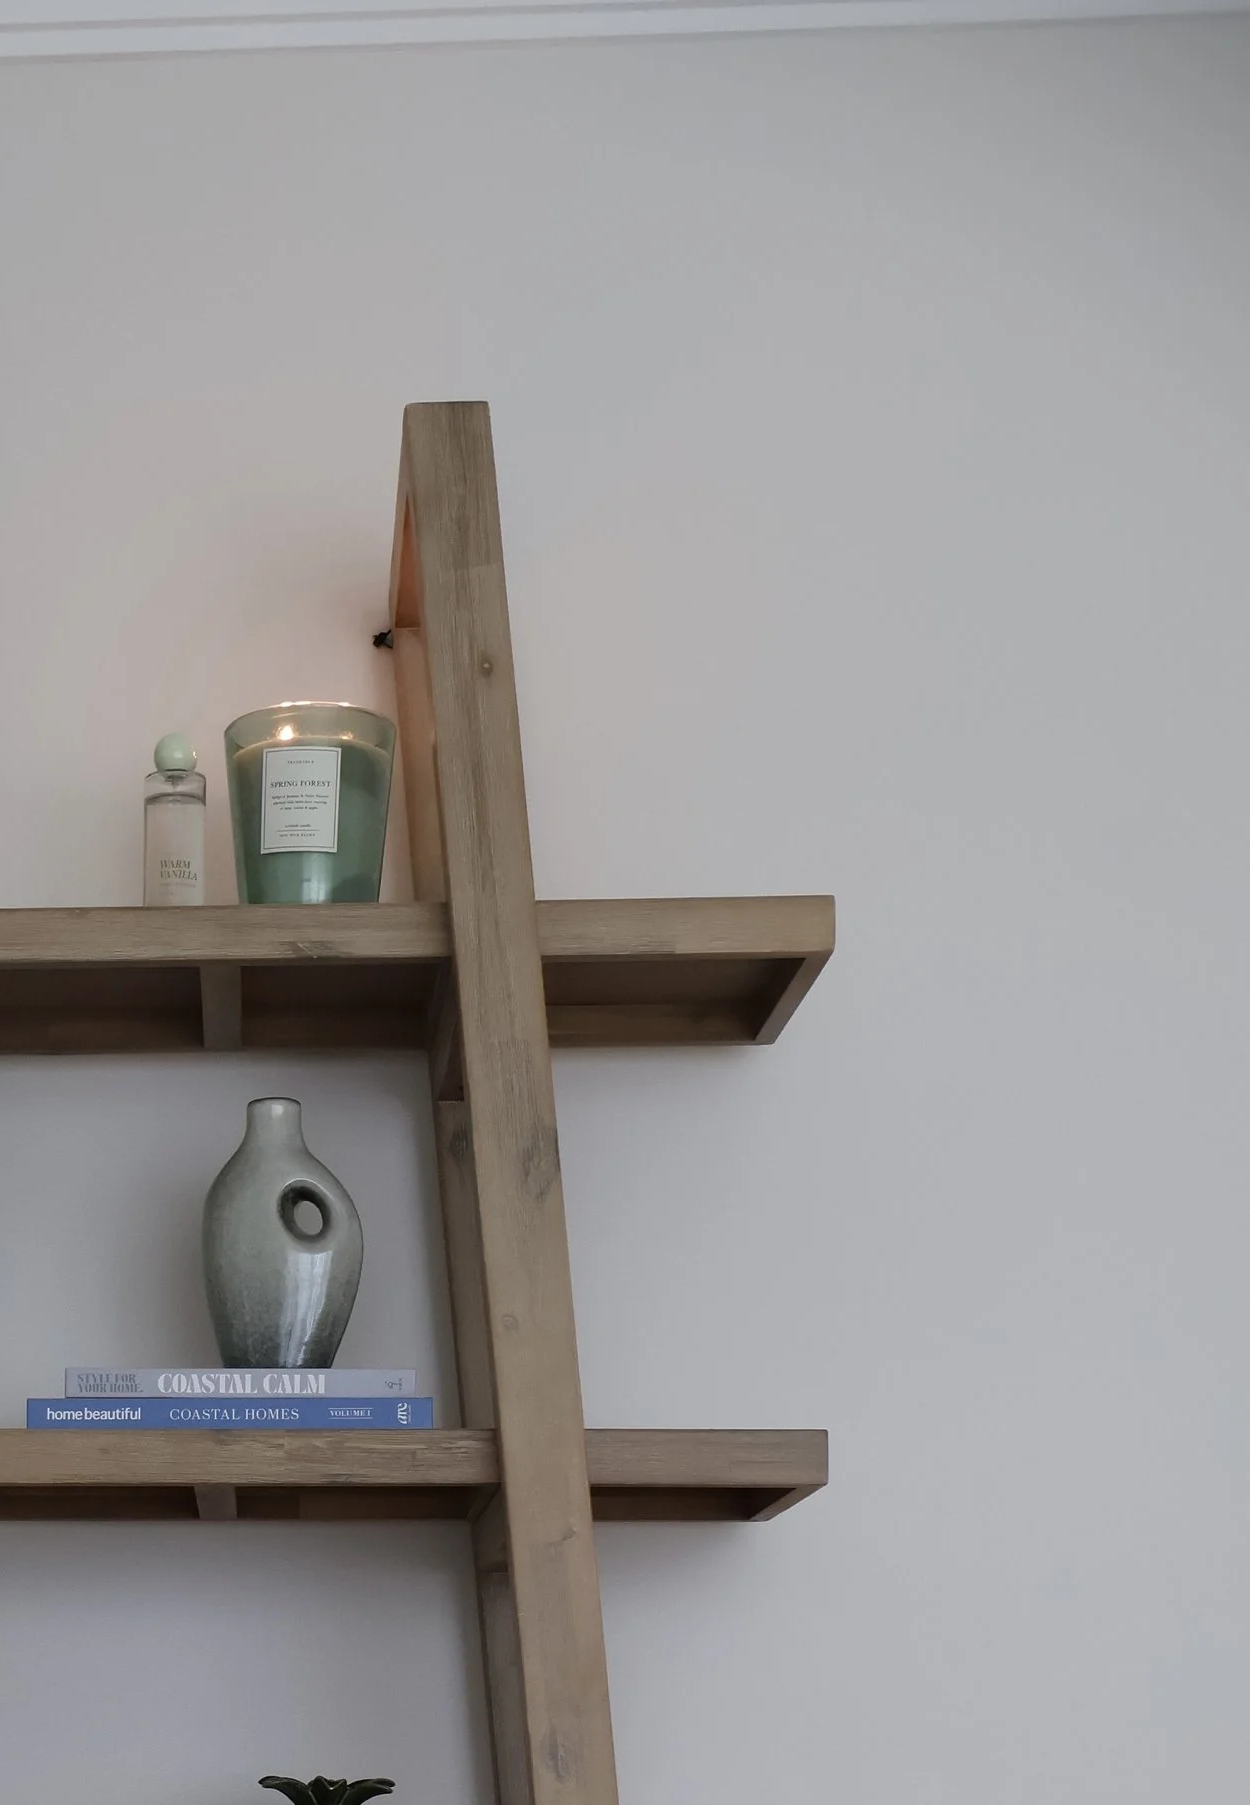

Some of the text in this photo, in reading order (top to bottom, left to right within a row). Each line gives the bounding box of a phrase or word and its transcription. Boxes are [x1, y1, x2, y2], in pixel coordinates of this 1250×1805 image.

[77, 1373, 136, 1384] STYLE FOR
[157, 1373, 326, 1394] COASTAL CALM
[78, 1384, 107, 1393] YOUR
[170, 1408, 300, 1420] COASTAL HOMES
[330, 1409, 365, 1417] VOLUME
